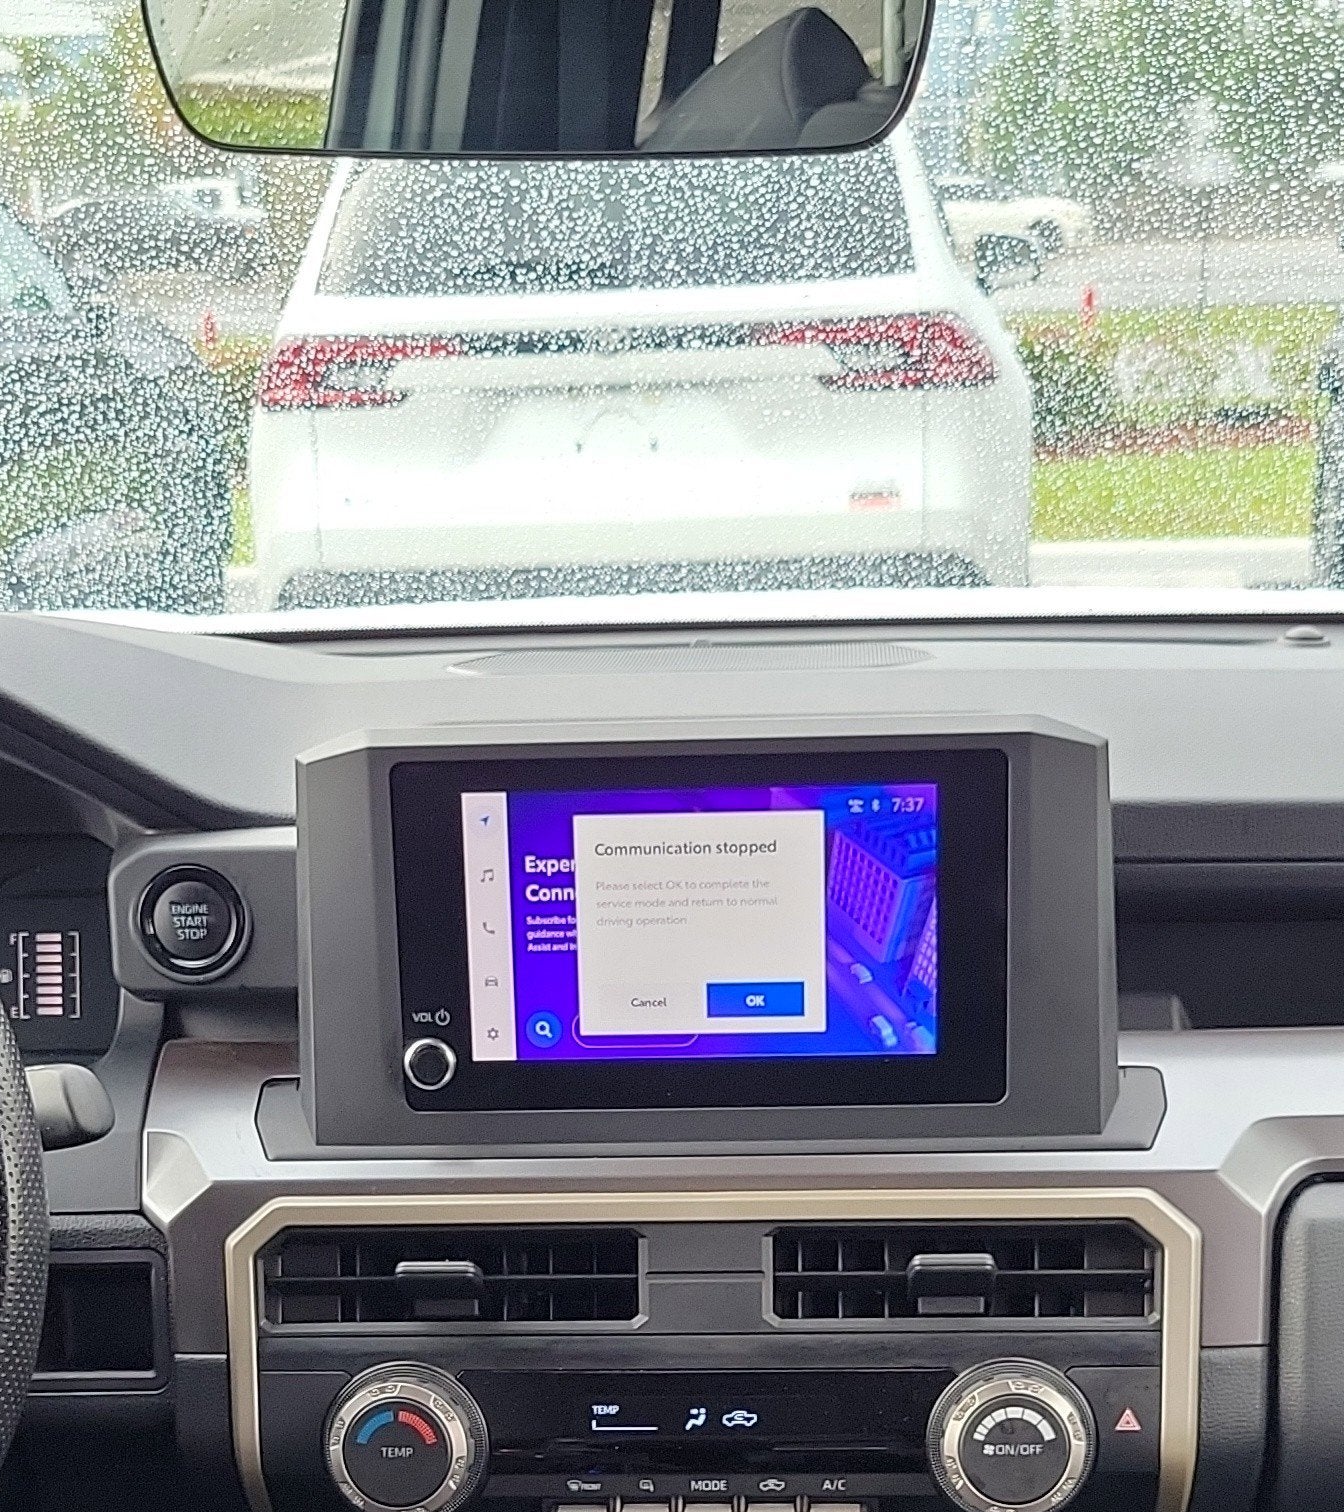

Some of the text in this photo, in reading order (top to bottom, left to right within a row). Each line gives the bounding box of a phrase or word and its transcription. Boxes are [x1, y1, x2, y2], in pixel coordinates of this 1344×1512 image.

[891, 796, 924, 812] 7:37
[594, 839, 777, 857] Communication stopped
[595, 878, 770, 892] Please select OK to complete the
[596, 896, 778, 909] service mode and return to normal
[171, 903, 209, 915] ENGINE
[173, 915, 208, 928] START
[596, 917, 633, 928] driving
[9, 932, 17, 946] F
[176, 928, 208, 940] STOP
[526, 929, 565, 941] guidance
[552, 942, 568, 951] and
[630, 997, 667, 1008] Cancel
[745, 994, 765, 1007] OK
[10, 1005, 19, 1019] E
[411, 1011, 433, 1023] VOL
[591, 1404, 620, 1415] TEMP
[381, 1446, 414, 1459] TEMP
[996, 1444, 1044, 1456] ON/OFF
[690, 1480, 728, 1492] MODE
[822, 1479, 847, 1491] A/C
